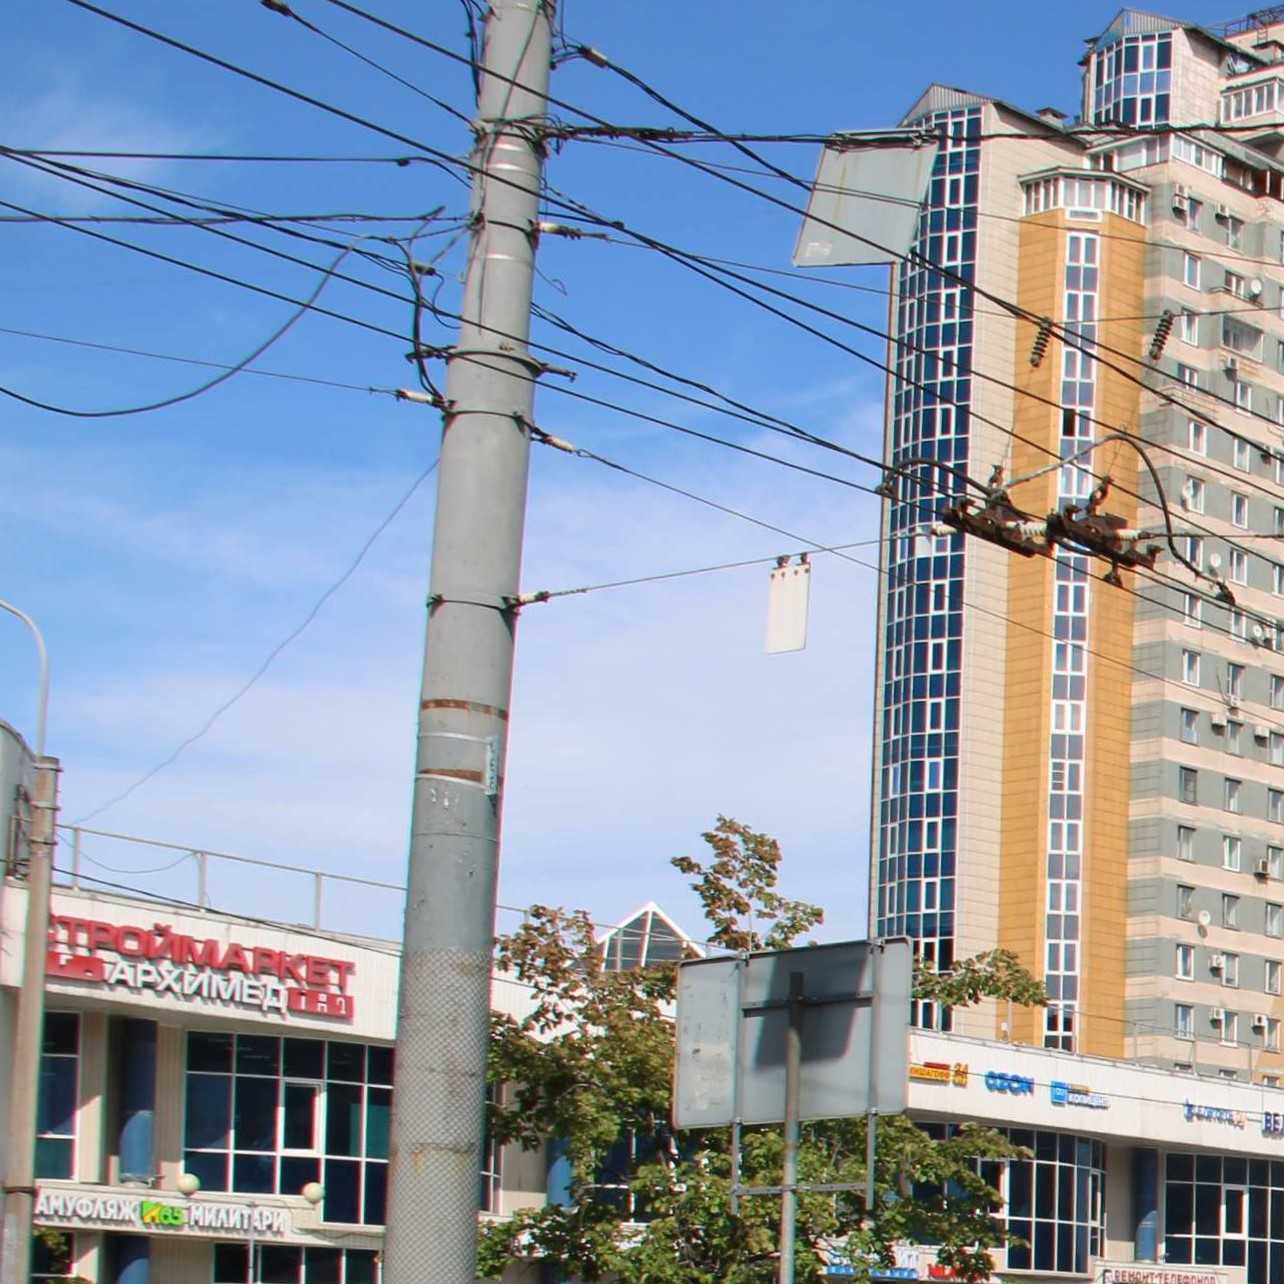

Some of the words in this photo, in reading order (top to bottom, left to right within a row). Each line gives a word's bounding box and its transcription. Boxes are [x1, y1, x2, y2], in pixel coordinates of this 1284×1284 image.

[106, 960, 290, 1017] АРХИМЕД
[34, 1193, 140, 1223] АМУФЛЯЖ
[187, 1203, 291, 1233] МИЛИТАРИ
